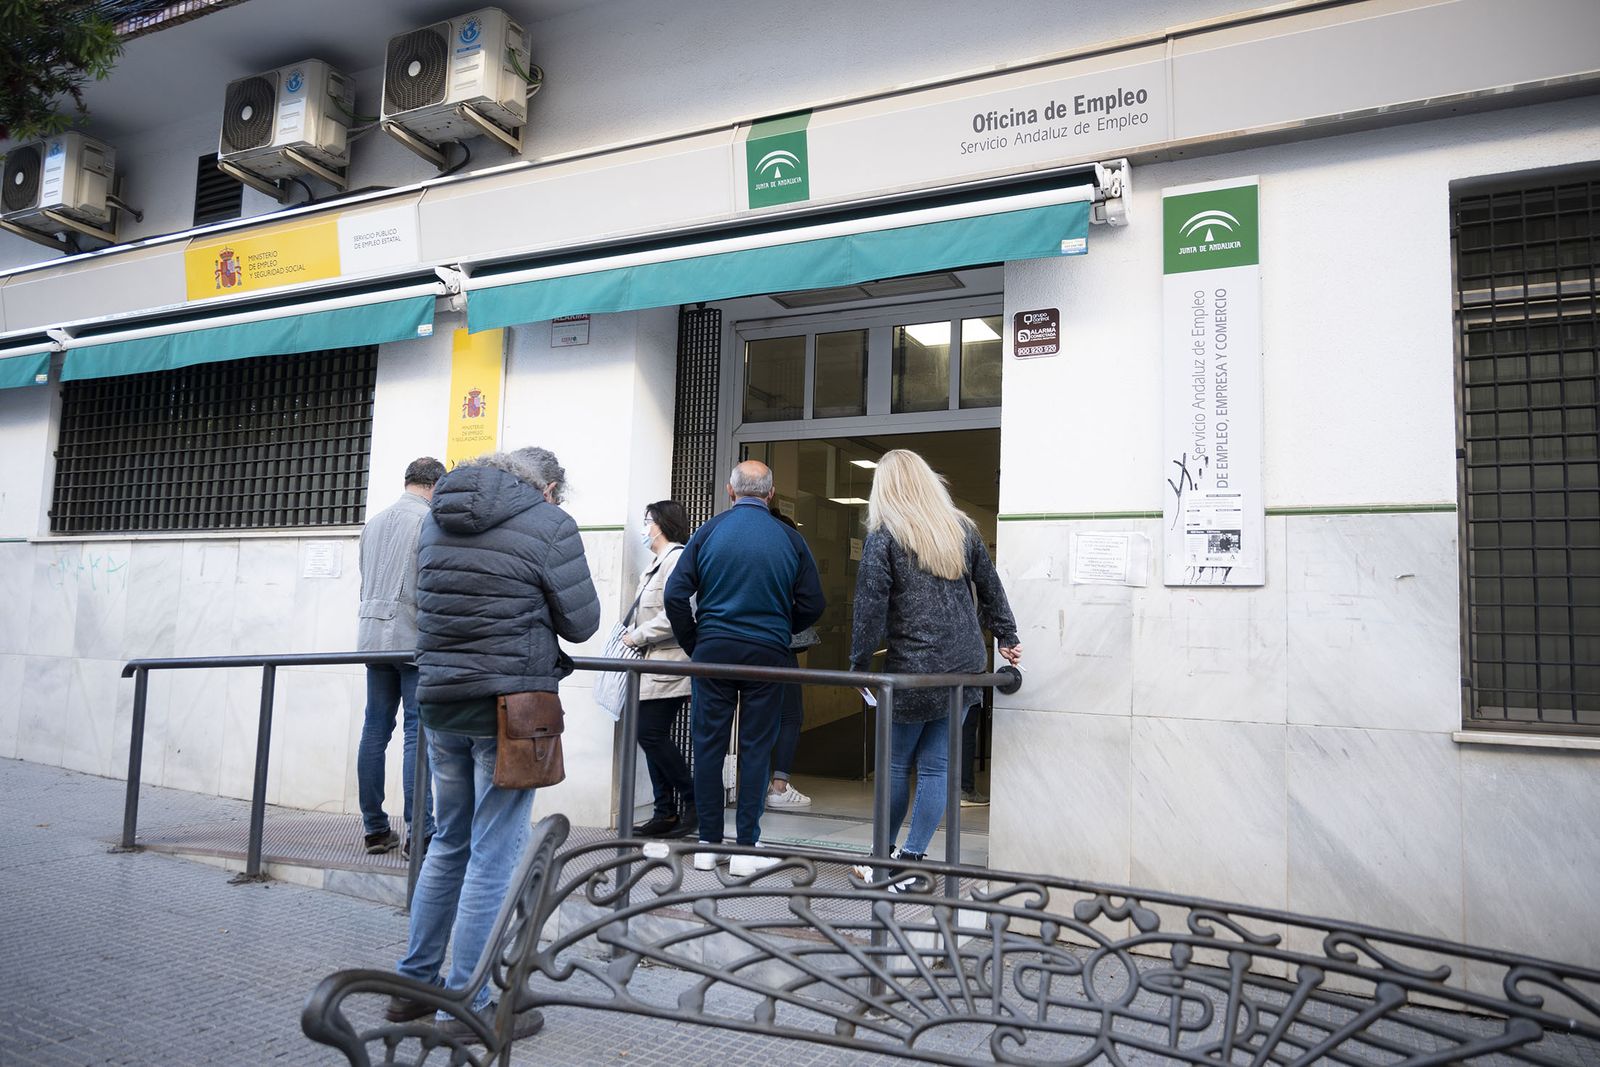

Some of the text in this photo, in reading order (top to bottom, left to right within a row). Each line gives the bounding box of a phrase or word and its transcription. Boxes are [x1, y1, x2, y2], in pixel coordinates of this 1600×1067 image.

[972, 87, 1148, 134] Oficina de Empleo
[960, 112, 1149, 155] Servicio Andaluz de Empleo
[755, 182, 769, 190] JUNTA
[353, 232, 375, 242] SERVICIO
[361, 239, 381, 249] EMPLEO
[381, 235, 401, 246] ESTATAL
[248, 250, 278, 261] MINISTERIO
[1178, 246, 1198, 255] JUNTA
[1199, 244, 1207, 253] DE
[249, 259, 278, 271] DE EMPLEO
[254, 267, 284, 279] SEGURIDAD
[285, 264, 306, 274] SOCIAL
[1030, 327, 1056, 335] ALARMA
[1191, 290, 1209, 461] Servicio Andaluz de Empleo
[1214, 288, 1230, 489] DE EMPLEO, EMPRESA Y COMERCIO
